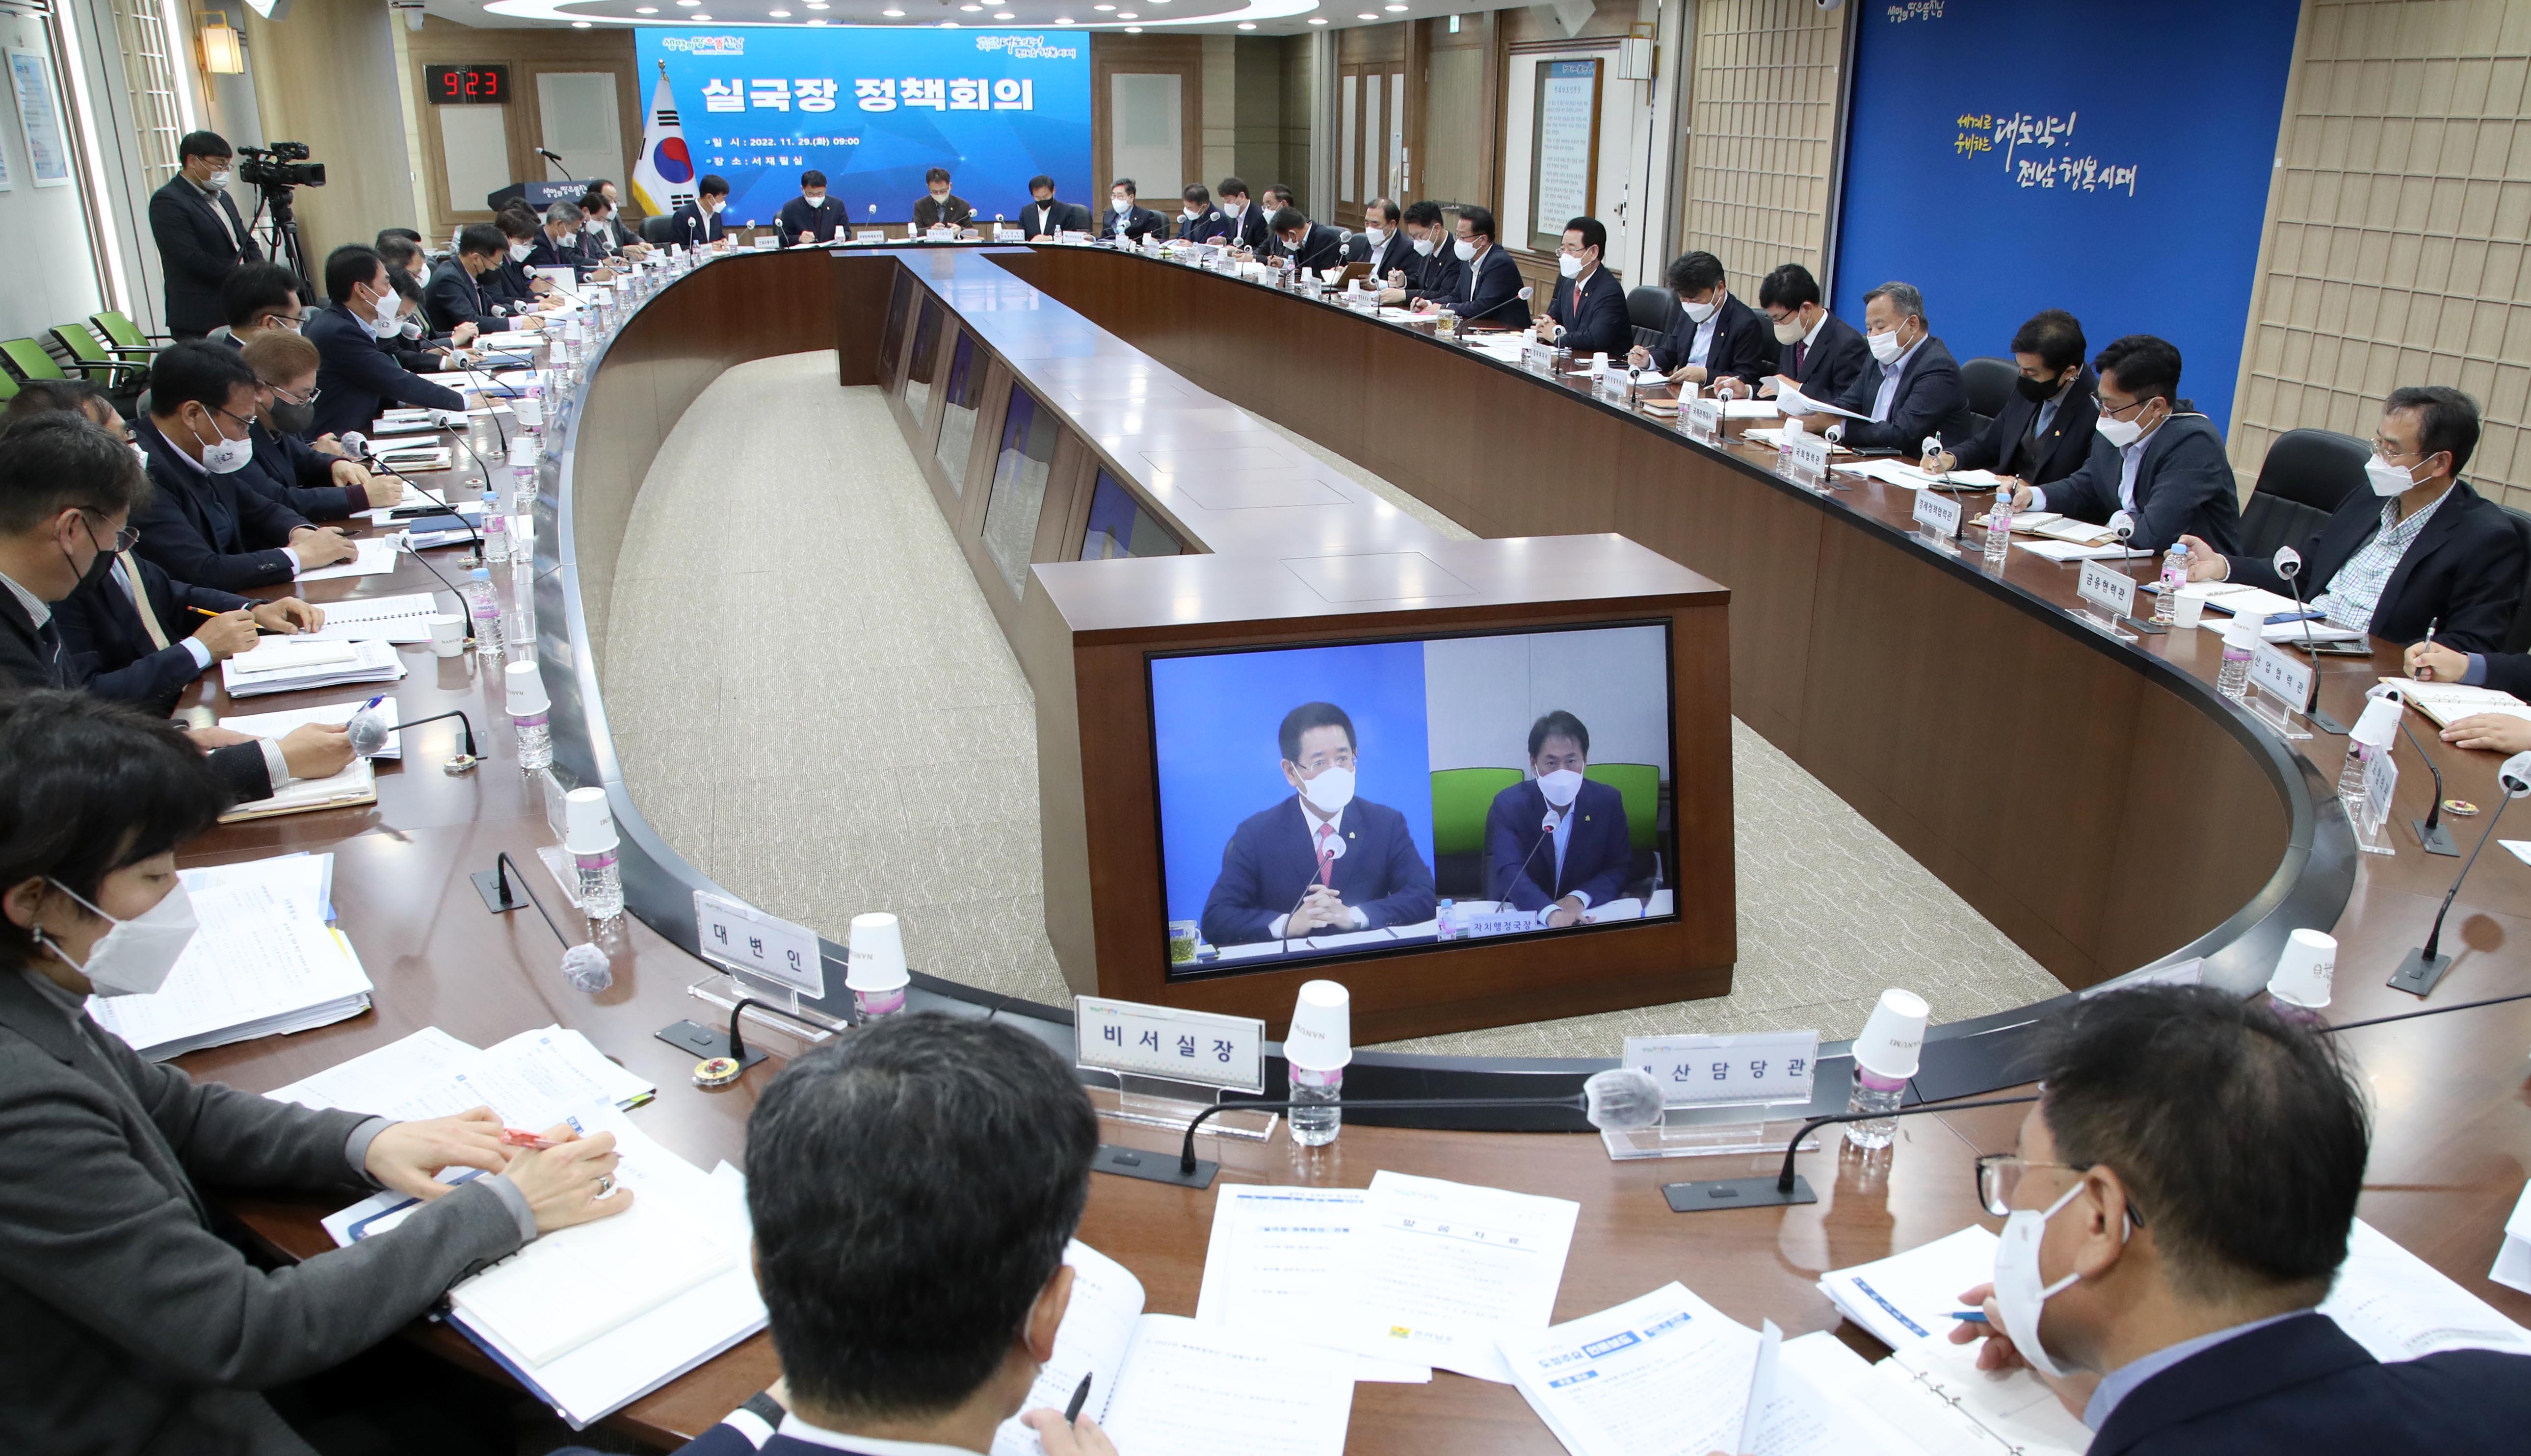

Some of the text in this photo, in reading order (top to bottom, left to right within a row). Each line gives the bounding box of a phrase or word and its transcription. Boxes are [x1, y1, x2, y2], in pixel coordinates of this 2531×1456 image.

[702, 76, 1034, 113] 실국장 정책회의
[833, 137, 860, 146] 09:00
[1994, 111, 2077, 173] 대도약!
[2016, 157, 2057, 188] 전남
[1919, 498, 1952, 521] 경제정책협력관
[2086, 573, 2125, 601] 금융협력관
[2254, 655, 2304, 695] 산업협력관
[1474, 920, 1531, 932] 자치행정국장
